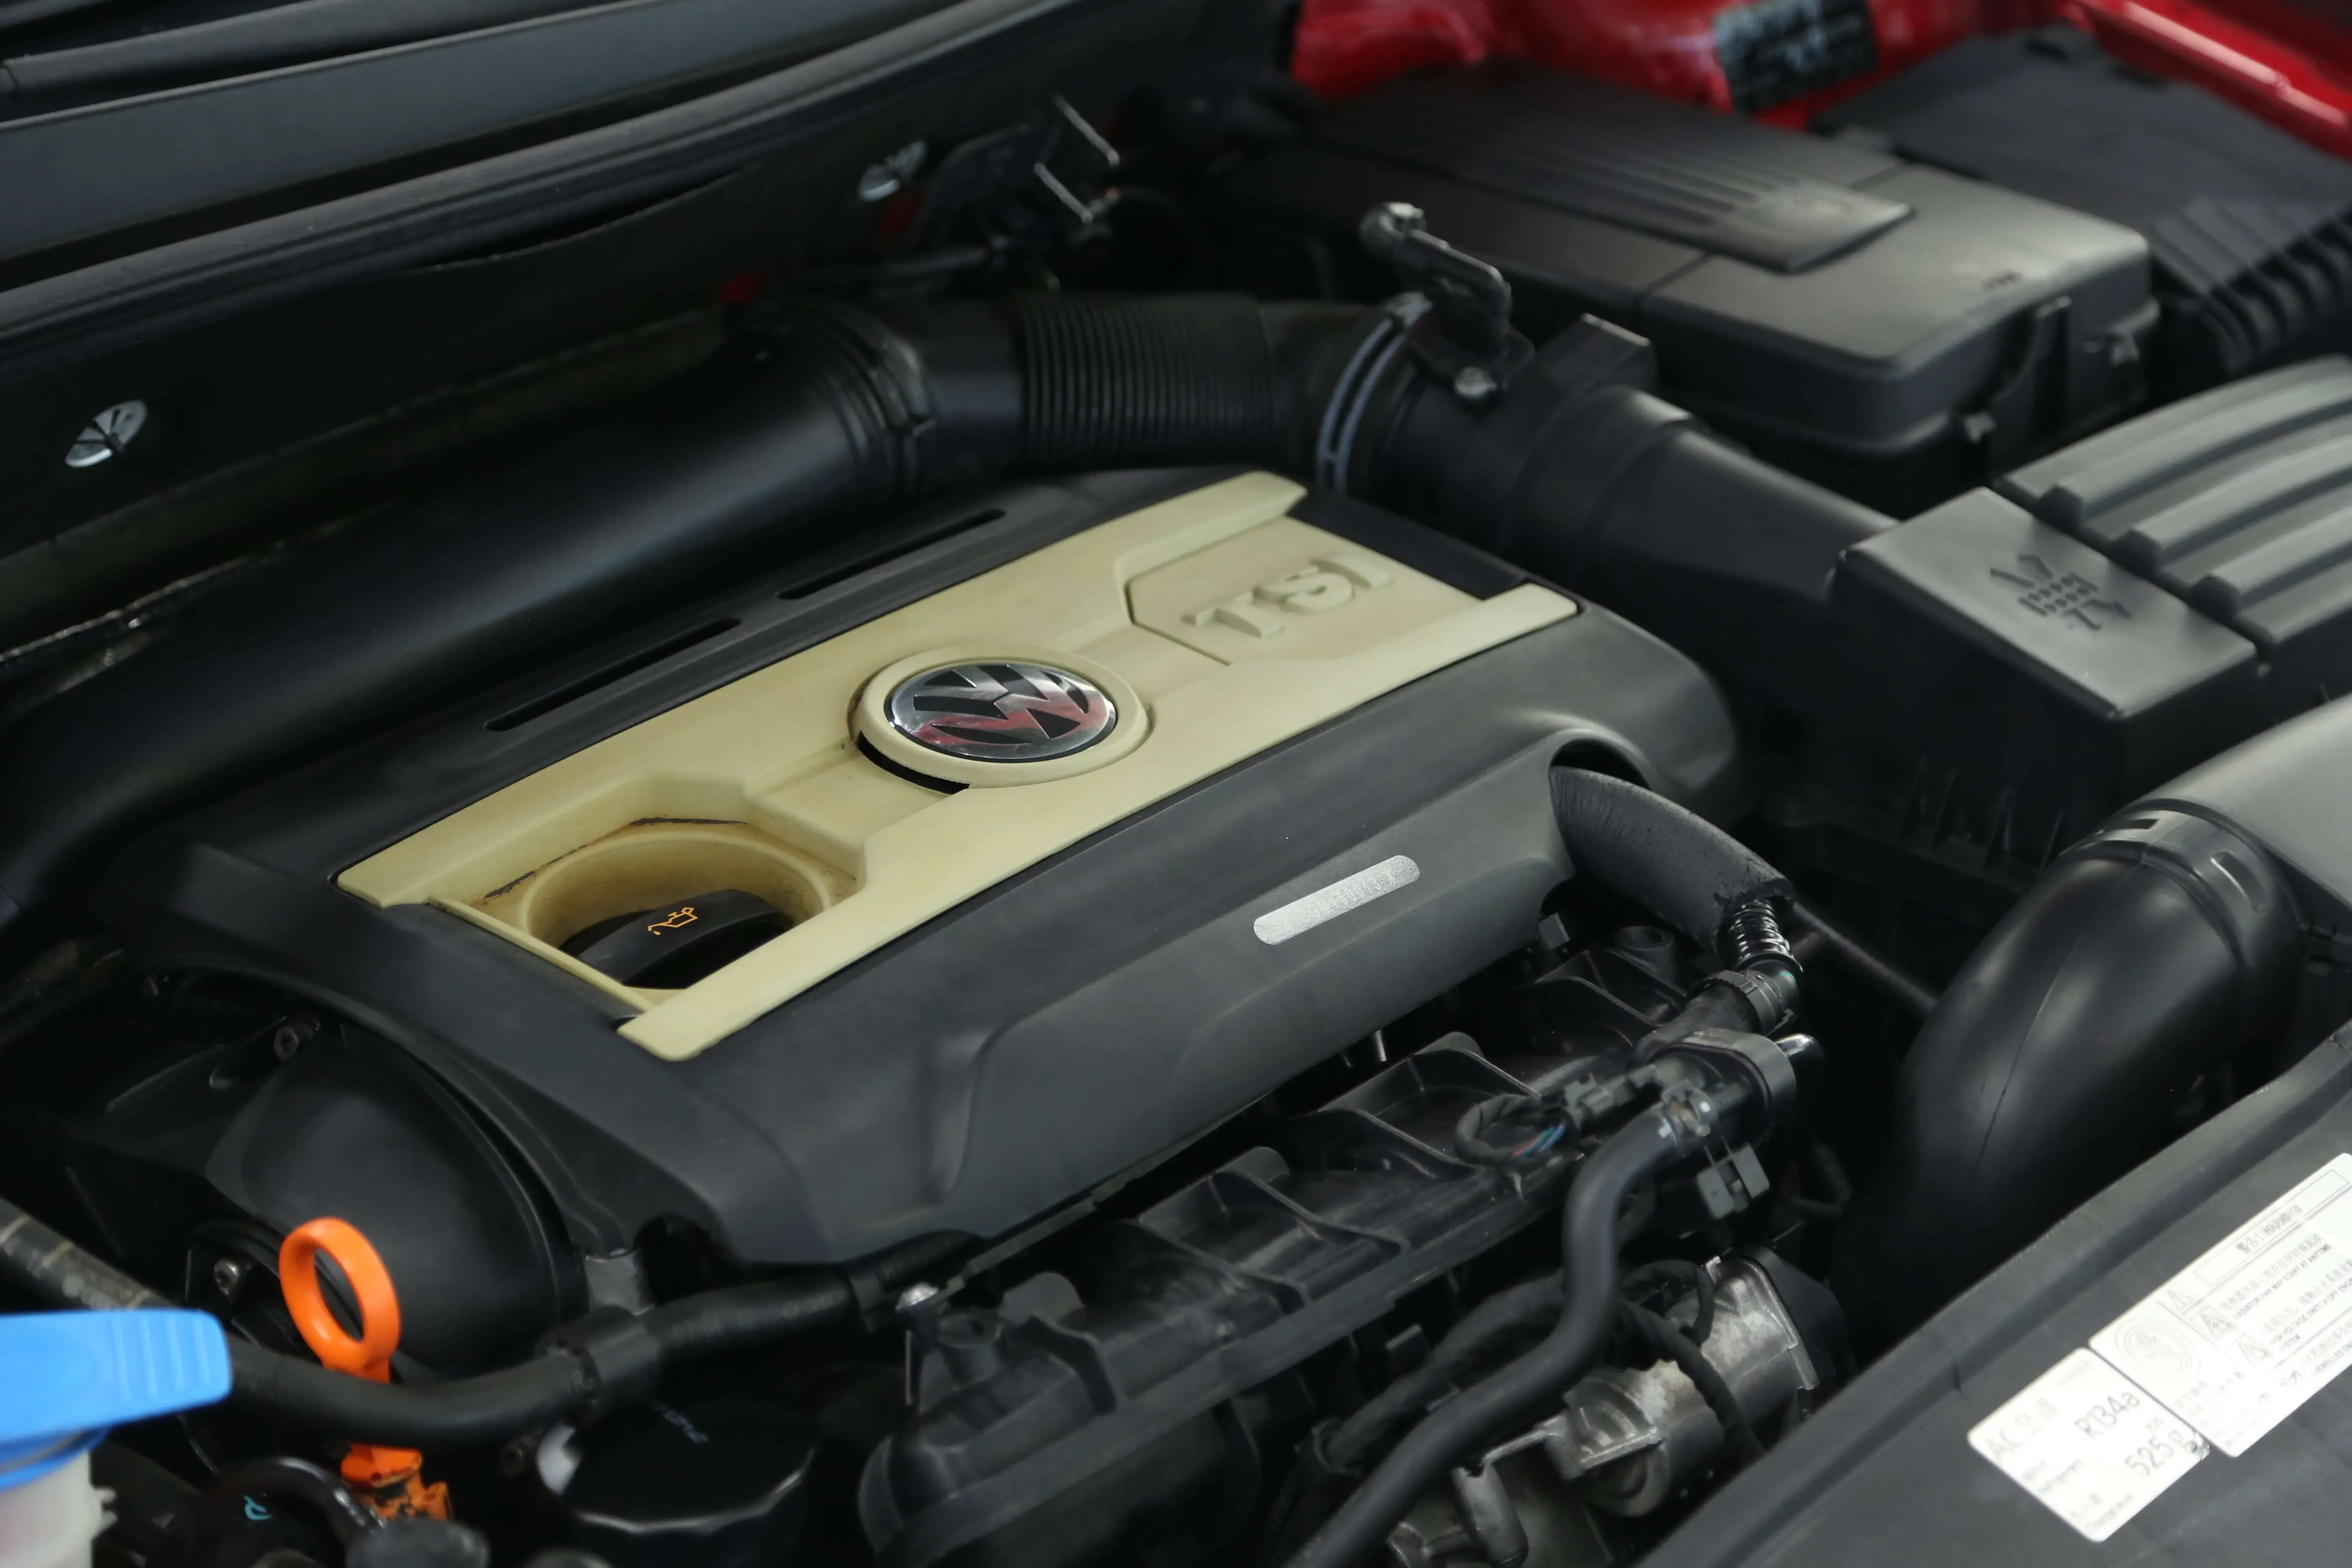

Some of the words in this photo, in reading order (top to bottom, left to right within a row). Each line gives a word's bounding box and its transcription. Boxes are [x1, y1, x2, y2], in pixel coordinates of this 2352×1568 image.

[1182, 553, 1390, 639] TSI
[2281, 1265, 2303, 1282] START
[2298, 1260, 2310, 1268] AT
[2305, 1243, 2332, 1263] ANYTIME
[2074, 1390, 2141, 1440] R134a
[2124, 1436, 2176, 1478] 525
